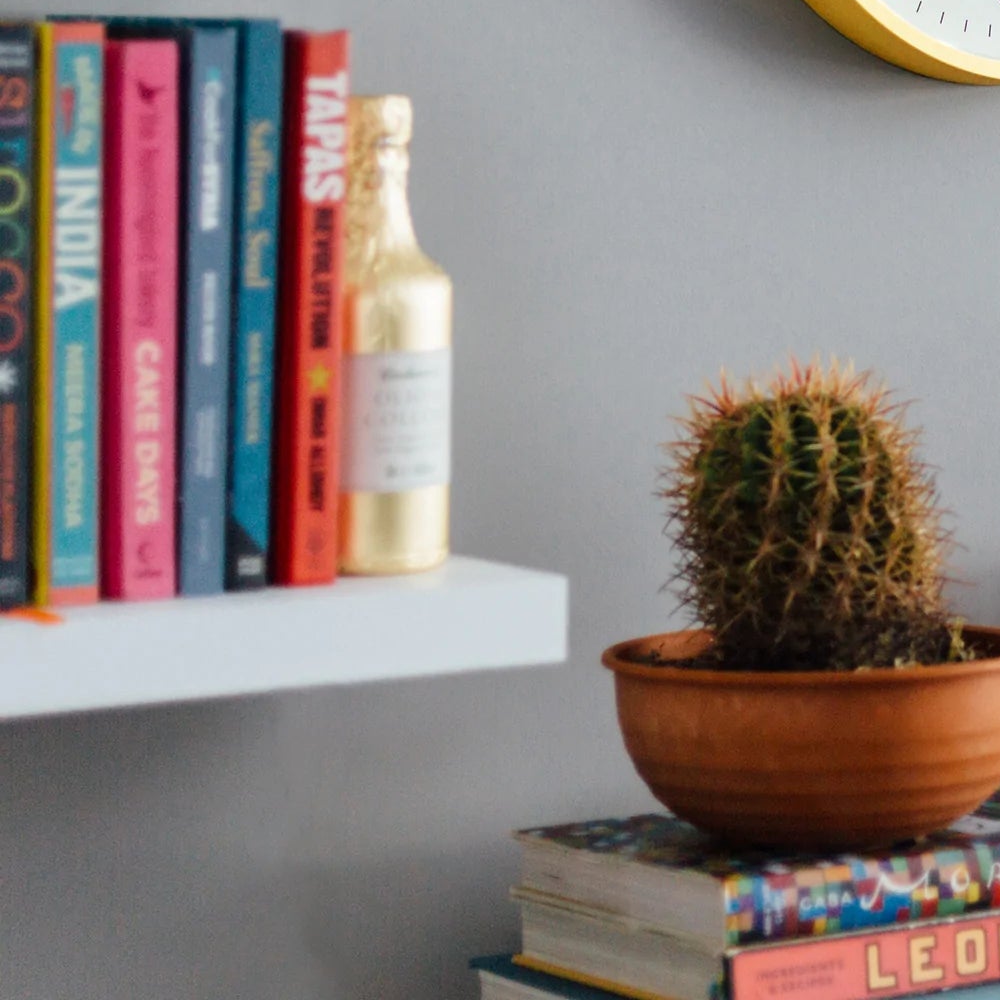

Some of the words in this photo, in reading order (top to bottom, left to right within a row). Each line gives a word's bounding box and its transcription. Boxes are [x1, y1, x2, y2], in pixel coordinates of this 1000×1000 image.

[303, 71, 346, 202] TAPAS
[54, 167, 99, 312] INDIA
[134, 340, 163, 432] CAKE
[134, 440, 163, 523] DAYS
[800, 890, 853, 910] CASA
